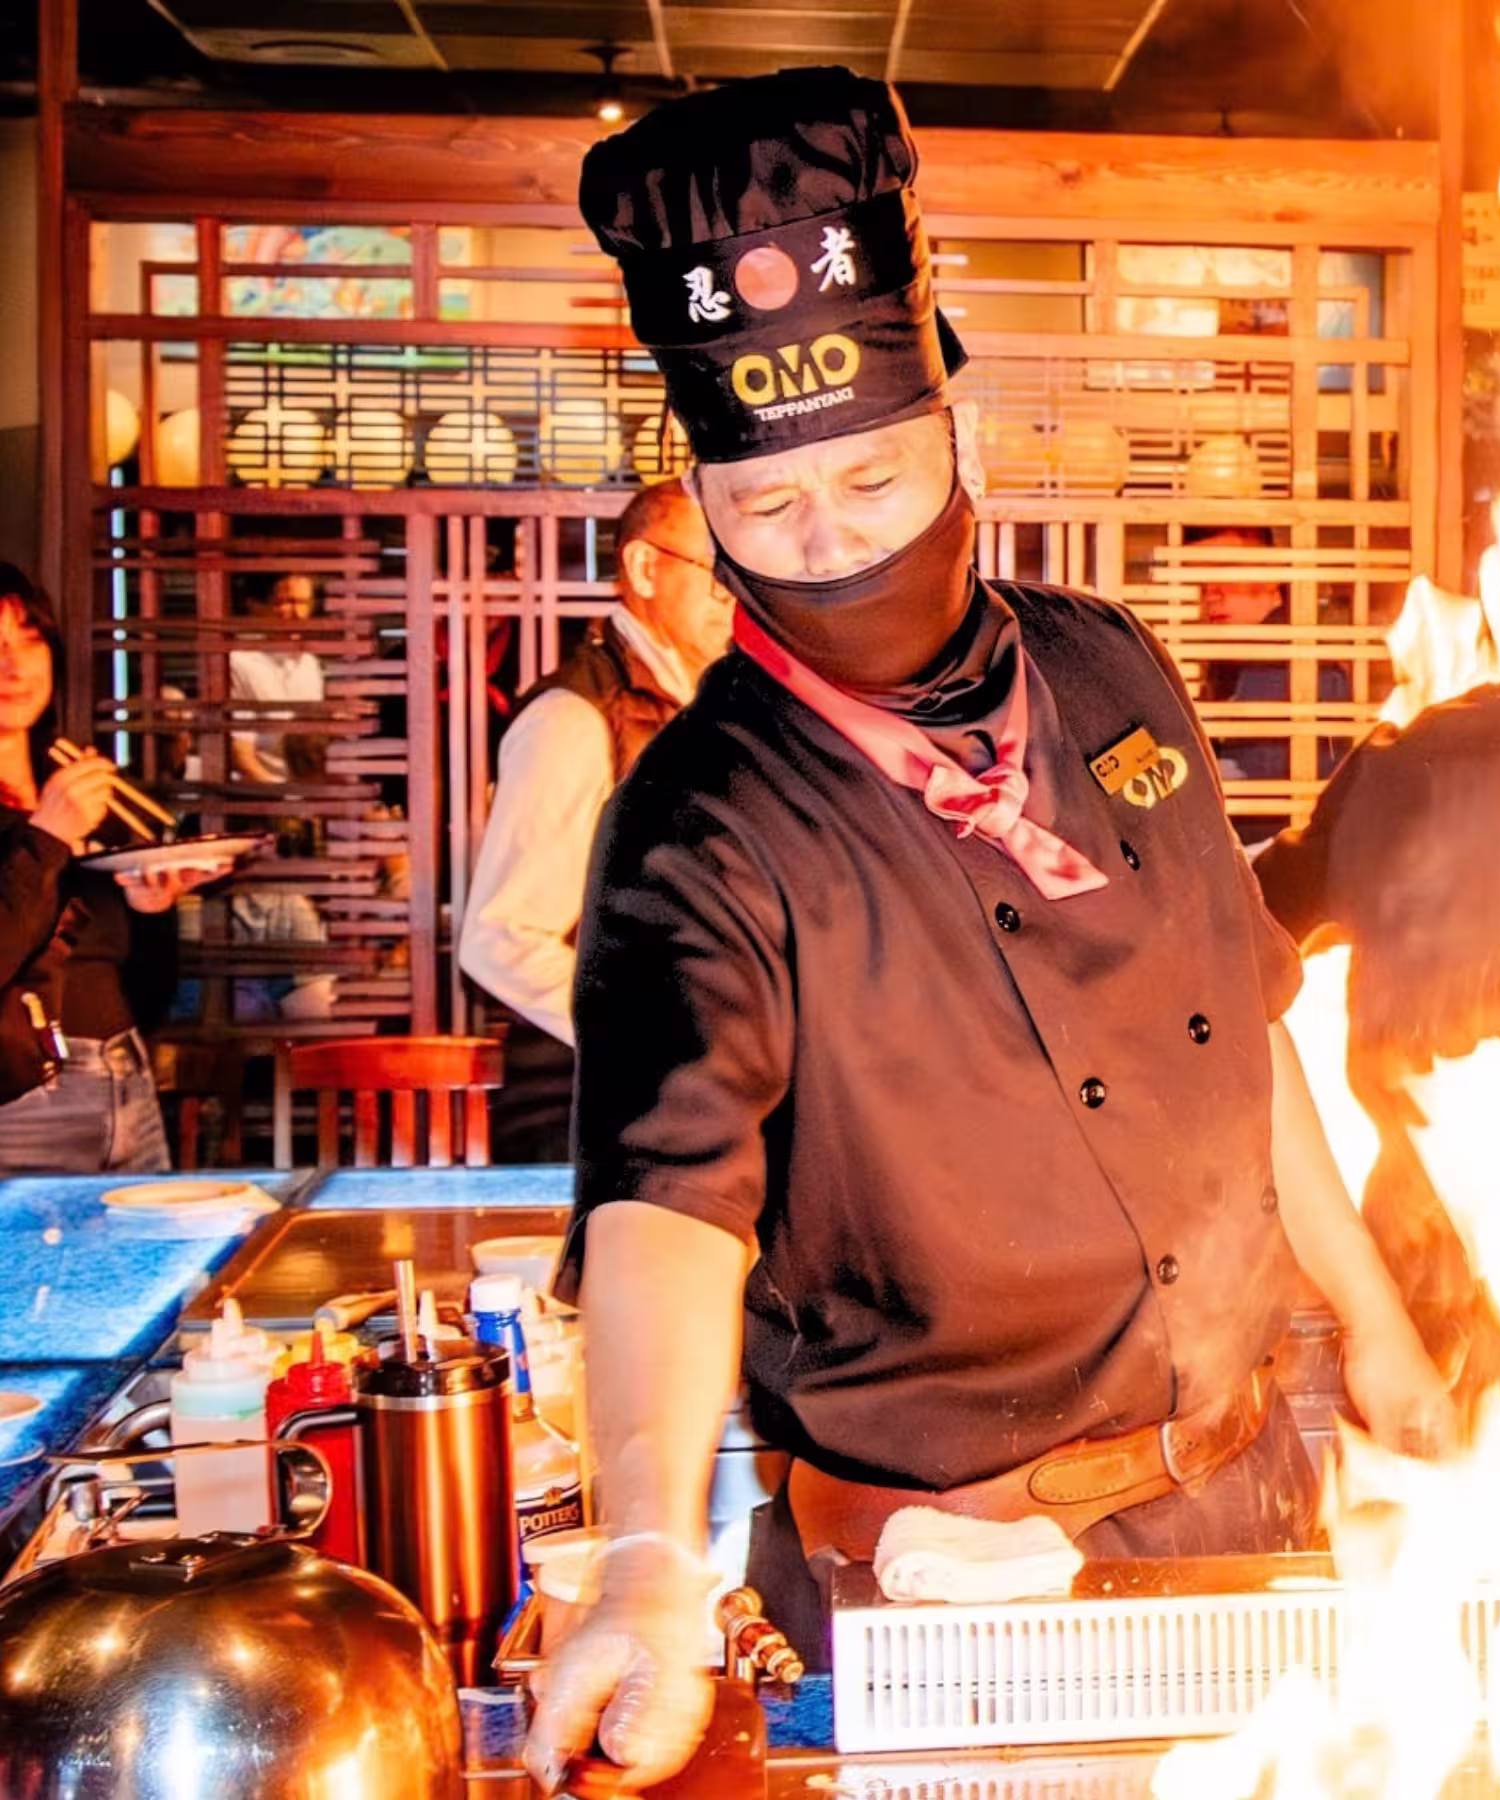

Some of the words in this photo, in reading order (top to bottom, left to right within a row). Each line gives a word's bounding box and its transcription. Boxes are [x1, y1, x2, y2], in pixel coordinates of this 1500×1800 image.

[682, 265, 732, 324] 忍
[809, 226, 857, 292] 者
[731, 333, 861, 406] OMO
[753, 386, 855, 422] TEPPANYAKI
